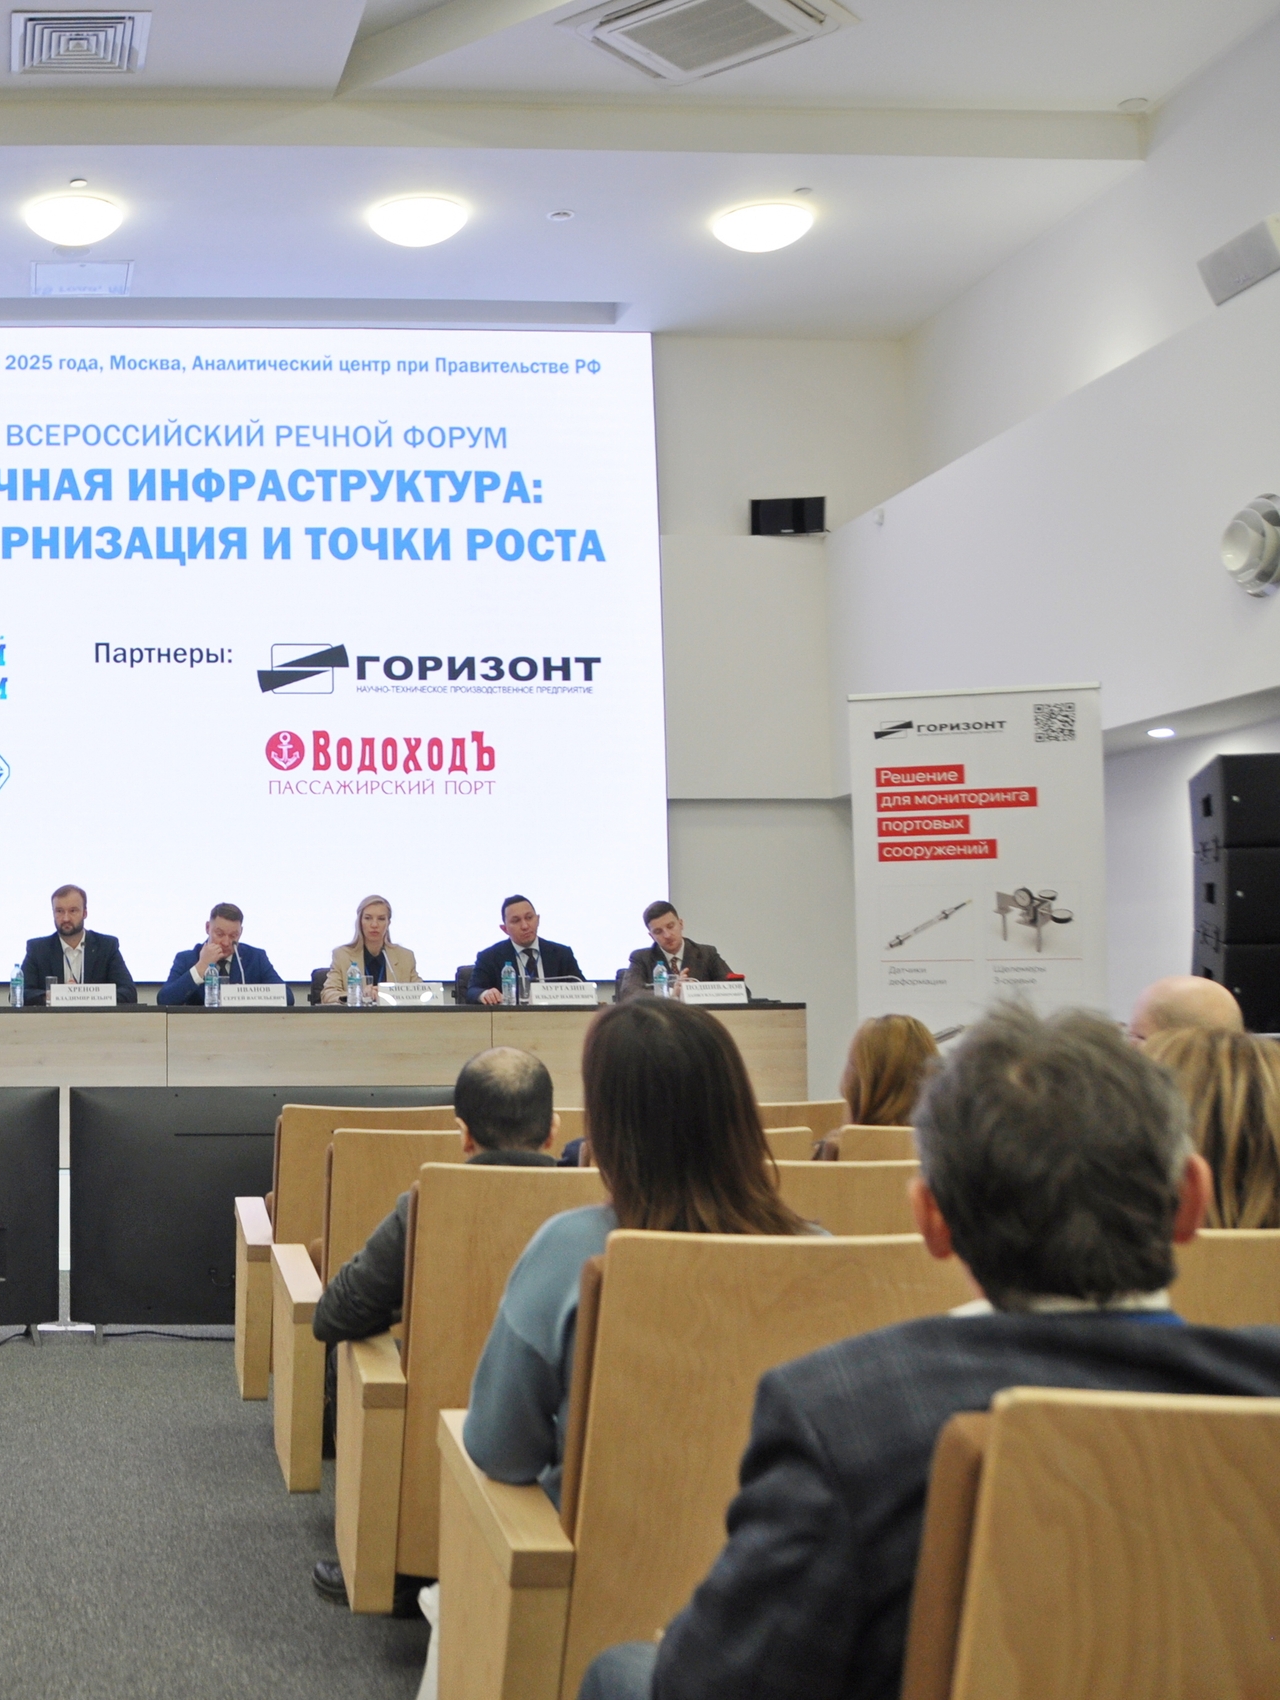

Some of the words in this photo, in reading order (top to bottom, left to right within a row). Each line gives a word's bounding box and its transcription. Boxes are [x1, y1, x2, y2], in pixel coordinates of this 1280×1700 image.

[4, 354, 54, 371] 2025
[58, 357, 104, 373] года,
[109, 354, 187, 373] Москва,
[191, 354, 333, 372] Аналитический
[339, 359, 392, 376] центр
[396, 360, 430, 376] при
[435, 357, 570, 376] Правительстве
[575, 359, 602, 375] РФ
[6, 418, 265, 447] ВСЕРОССИЙСКИЙ
[275, 419, 393, 448] РЕЧНОЙ
[402, 425, 508, 449] ФОРУМ
[128, 467, 543, 504] ИНФРАСТРУКТУРА:
[262, 526, 292, 561] И
[303, 526, 452, 562] ТОЧКИ
[466, 527, 607, 563] РОСТА
[94, 641, 233, 669] Партнеры:
[356, 655, 602, 682] ГОРИЗОНТ
[356, 685, 448, 694] НАУЧНО-ТЕХНИЧЕСКОЕ
[450, 685, 534, 695] ПРОИЗВОДСТВЕННОЕ
[536, 685, 593, 695] ПРЕДПРИЯТИЕ
[917, 720, 1007, 733] ГОРИЗОНТ
[880, 770, 959, 784] Решение
[268, 778, 435, 795] ПАССАЖИРСКИЙ
[444, 779, 497, 795] ПОРТ
[880, 794, 912, 808] для
[914, 790, 1030, 806] мониторинга
[881, 818, 964, 833] портовых
[882, 840, 989, 859] сооружений
[67, 985, 101, 993] ХРЕНОВ
